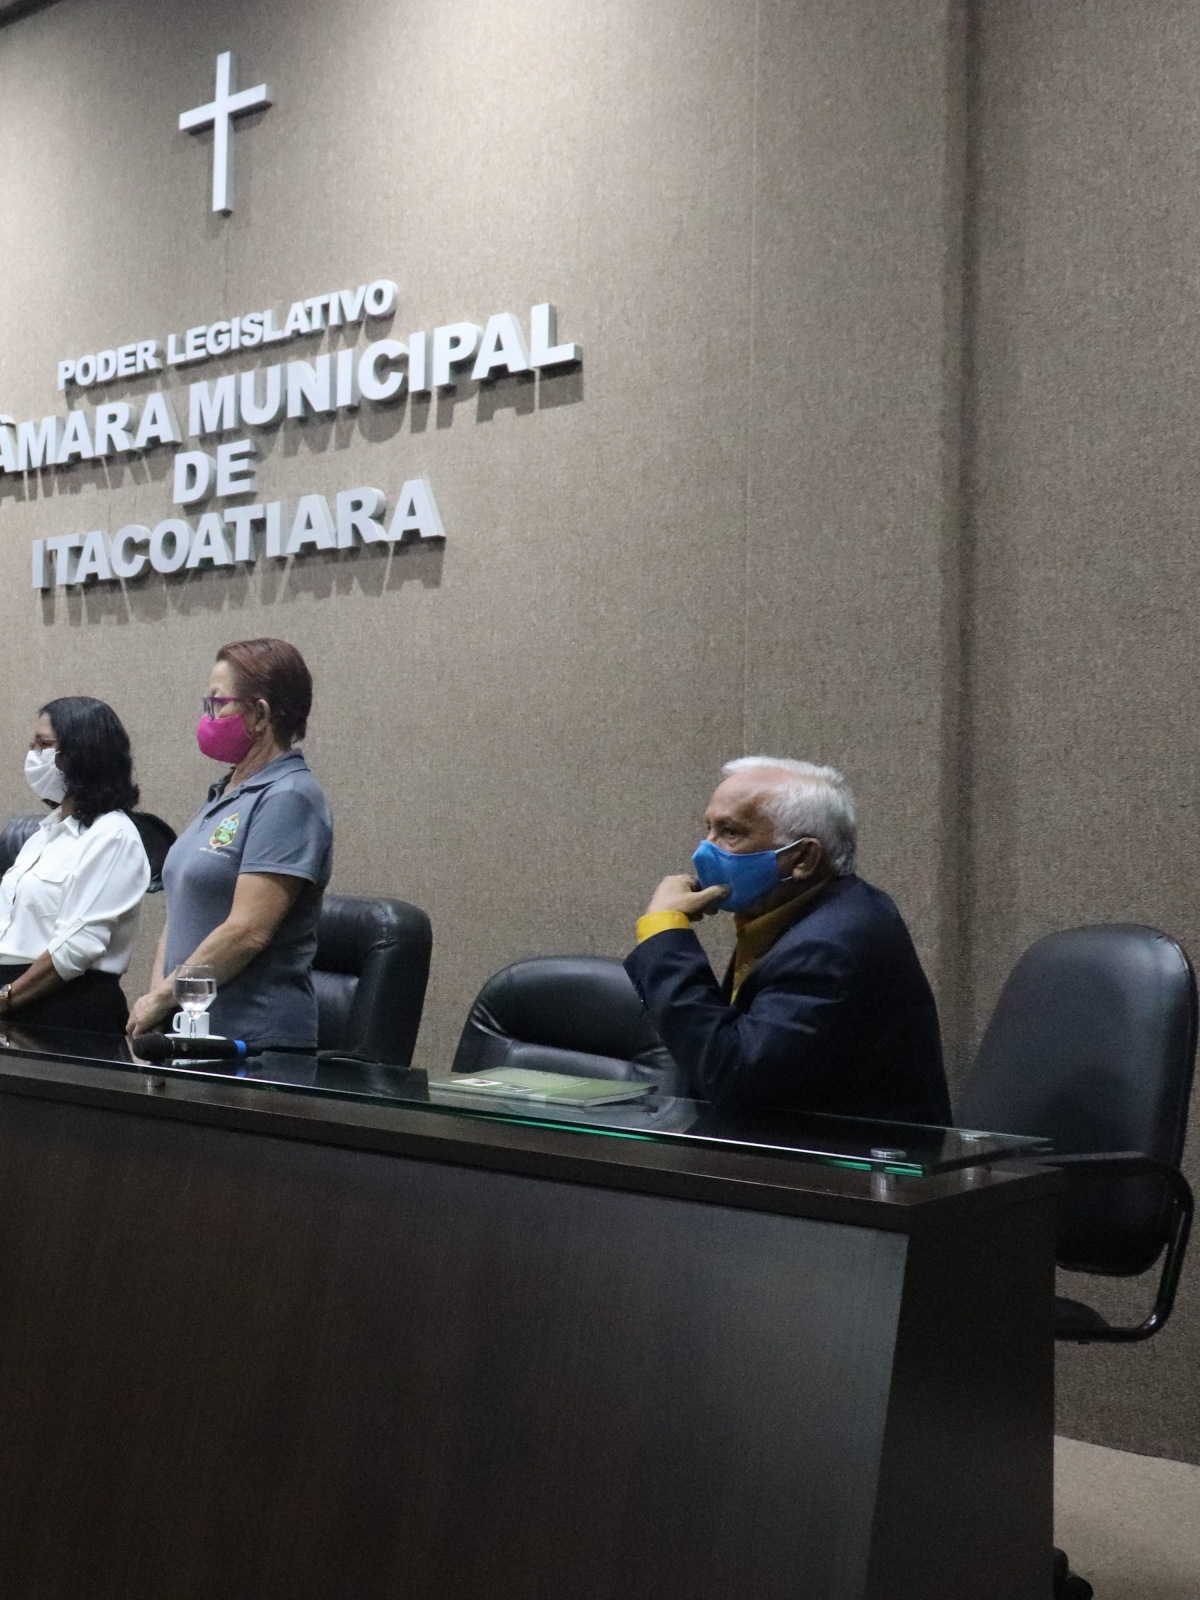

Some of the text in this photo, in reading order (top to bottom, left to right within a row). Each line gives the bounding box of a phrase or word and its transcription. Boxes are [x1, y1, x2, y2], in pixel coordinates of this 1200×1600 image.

[57, 279, 399, 391] PODER LEGISLATIVO
[188, 303, 582, 436] MUNICIPAL
[172, 439, 257, 505] DE
[31, 478, 446, 589] ITACOATIARA
